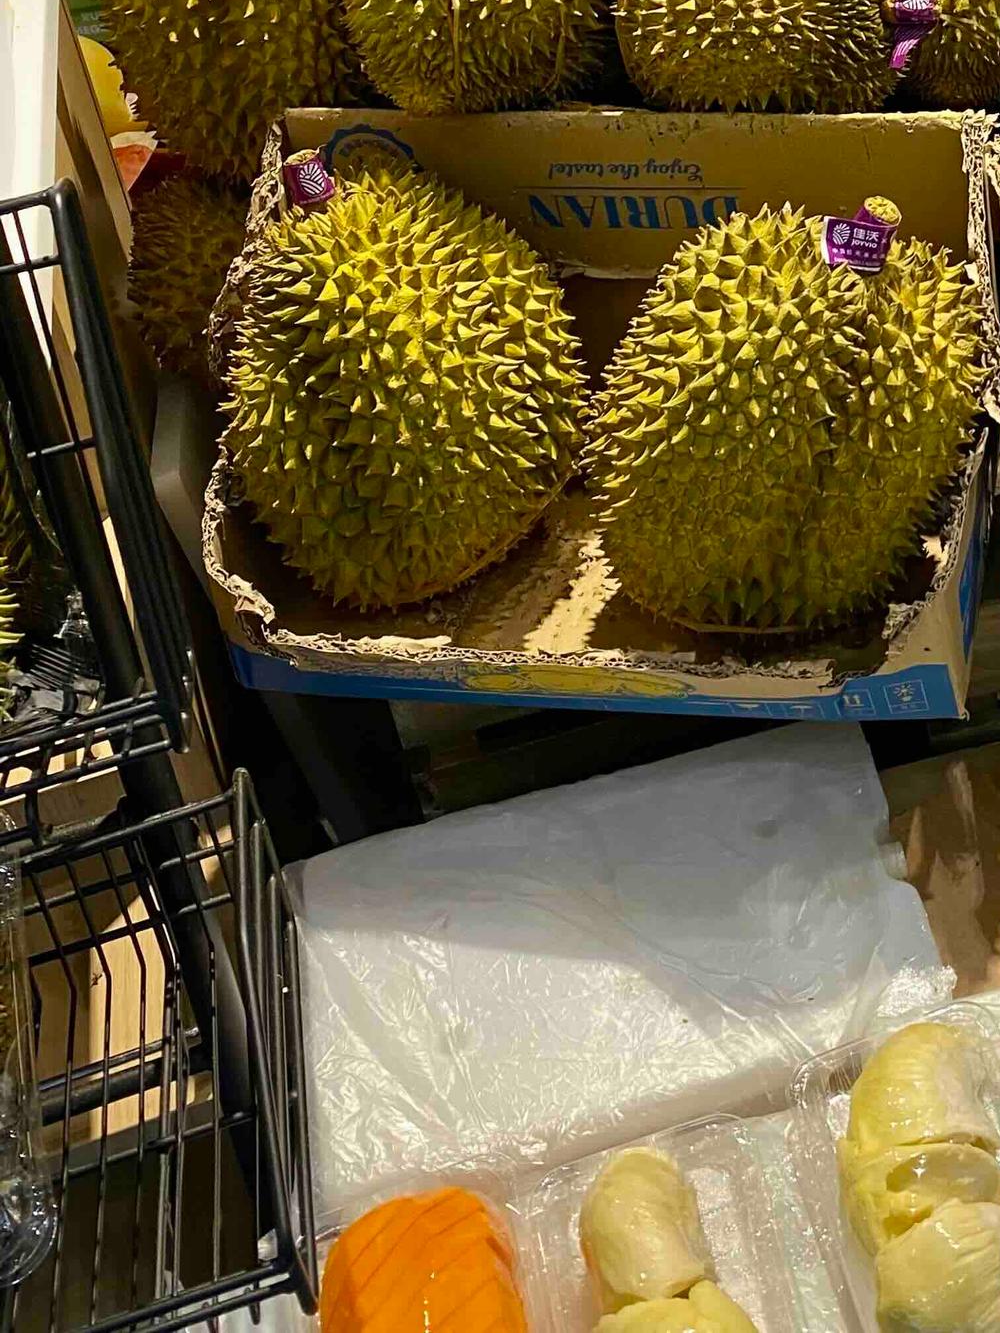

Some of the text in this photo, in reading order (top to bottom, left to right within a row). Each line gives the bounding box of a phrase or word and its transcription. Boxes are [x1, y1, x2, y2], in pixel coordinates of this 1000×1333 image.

[549, 157, 704, 183] Enjoy the taste!
[528, 194, 742, 230] DURIAN
